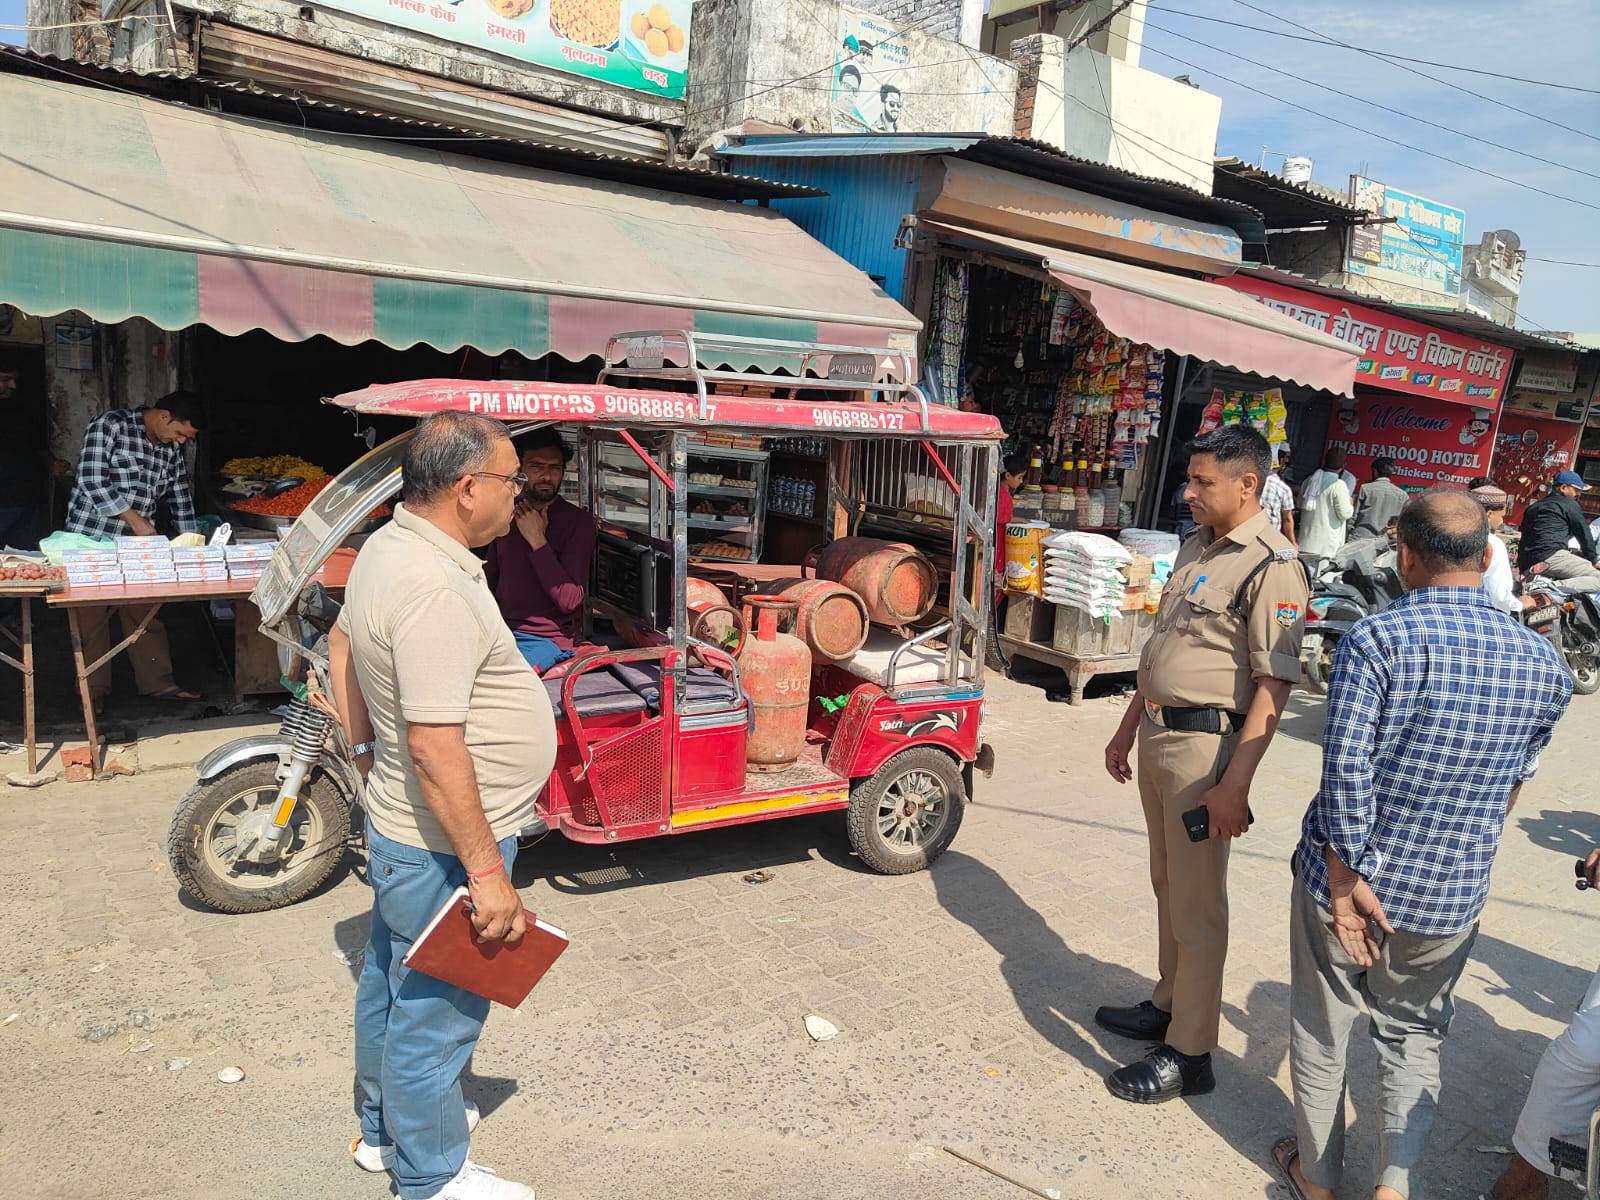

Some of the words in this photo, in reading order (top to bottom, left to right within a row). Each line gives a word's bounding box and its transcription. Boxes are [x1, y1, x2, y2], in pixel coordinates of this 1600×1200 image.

[430, 4, 457, 22] केक
[487, 22, 525, 44] इमरती
[561, 45, 607, 68] गुलदाना
[1385, 329, 1422, 361] एण्ड
[1421, 332, 1467, 371] चिकन
[1467, 345, 1507, 380] कॉर्नर
[469, 392, 500, 412] PM
[506, 392, 595, 414] MOTORS
[604, 395, 716, 421] 906888517
[1368, 404, 1450, 431] Welcome
[813, 408, 904, 430] 9068885127
[1369, 444, 1428, 465] FAROOQ
[1430, 450, 1481, 468] HOTEL
[1392, 466, 1434, 481] Chicken
